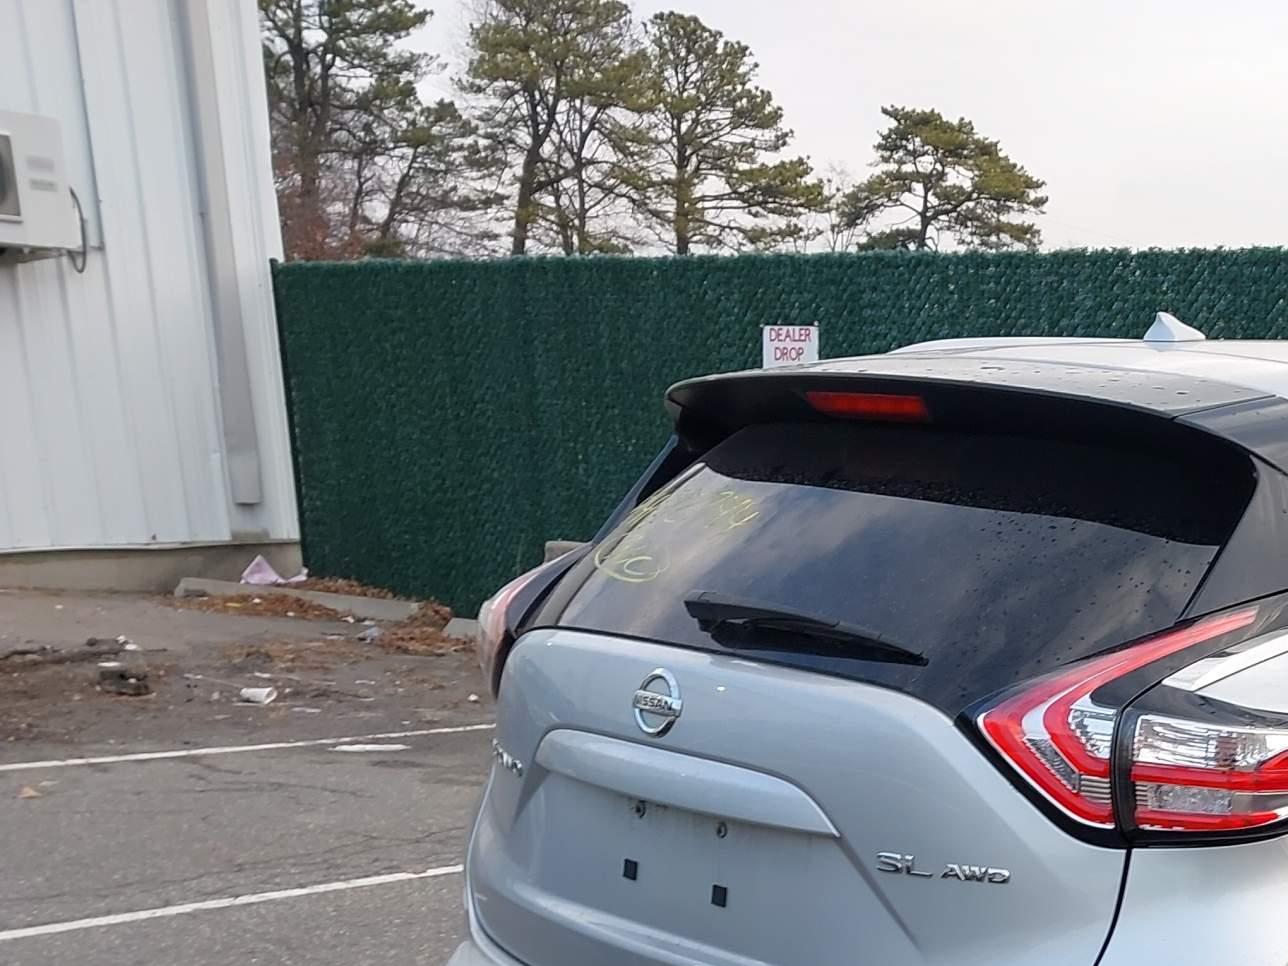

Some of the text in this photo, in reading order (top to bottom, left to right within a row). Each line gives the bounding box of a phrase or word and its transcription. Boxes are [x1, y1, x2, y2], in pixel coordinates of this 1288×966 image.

[769, 327, 812, 342] DEALER
[774, 346, 804, 361] DROP
[876, 851, 1011, 884] SL AWD
